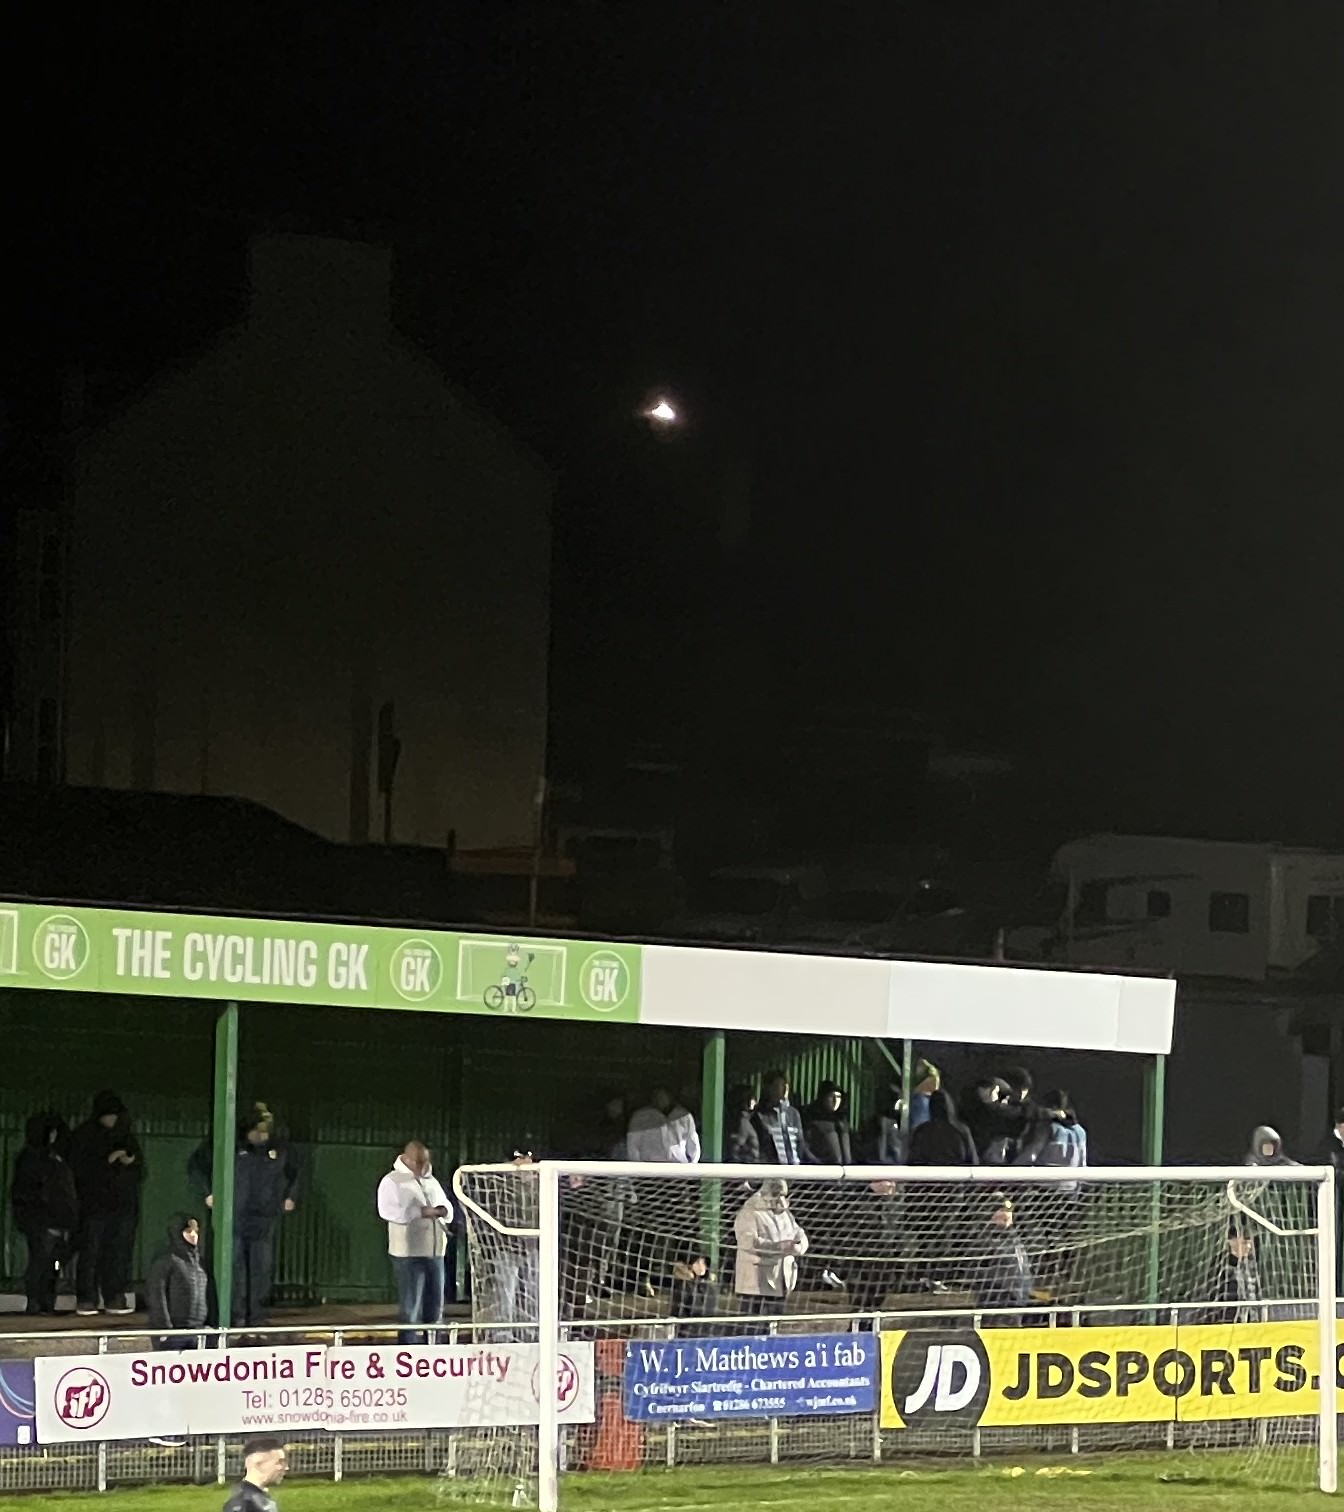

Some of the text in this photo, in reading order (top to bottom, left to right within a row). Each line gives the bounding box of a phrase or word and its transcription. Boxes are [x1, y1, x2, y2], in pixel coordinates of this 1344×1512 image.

[45, 933, 77, 969] GK
[112, 927, 369, 991] THE CYCLING GK
[400, 956, 431, 993] GK
[590, 967, 619, 1002] GK
[131, 1350, 511, 1386] Snowdonia Fire & Security
[640, 1341, 865, 1378] W. J. Matthews a'i fab
[904, 1345, 981, 1414] JD
[242, 1388, 407, 1408] Tel: 01286 650235
